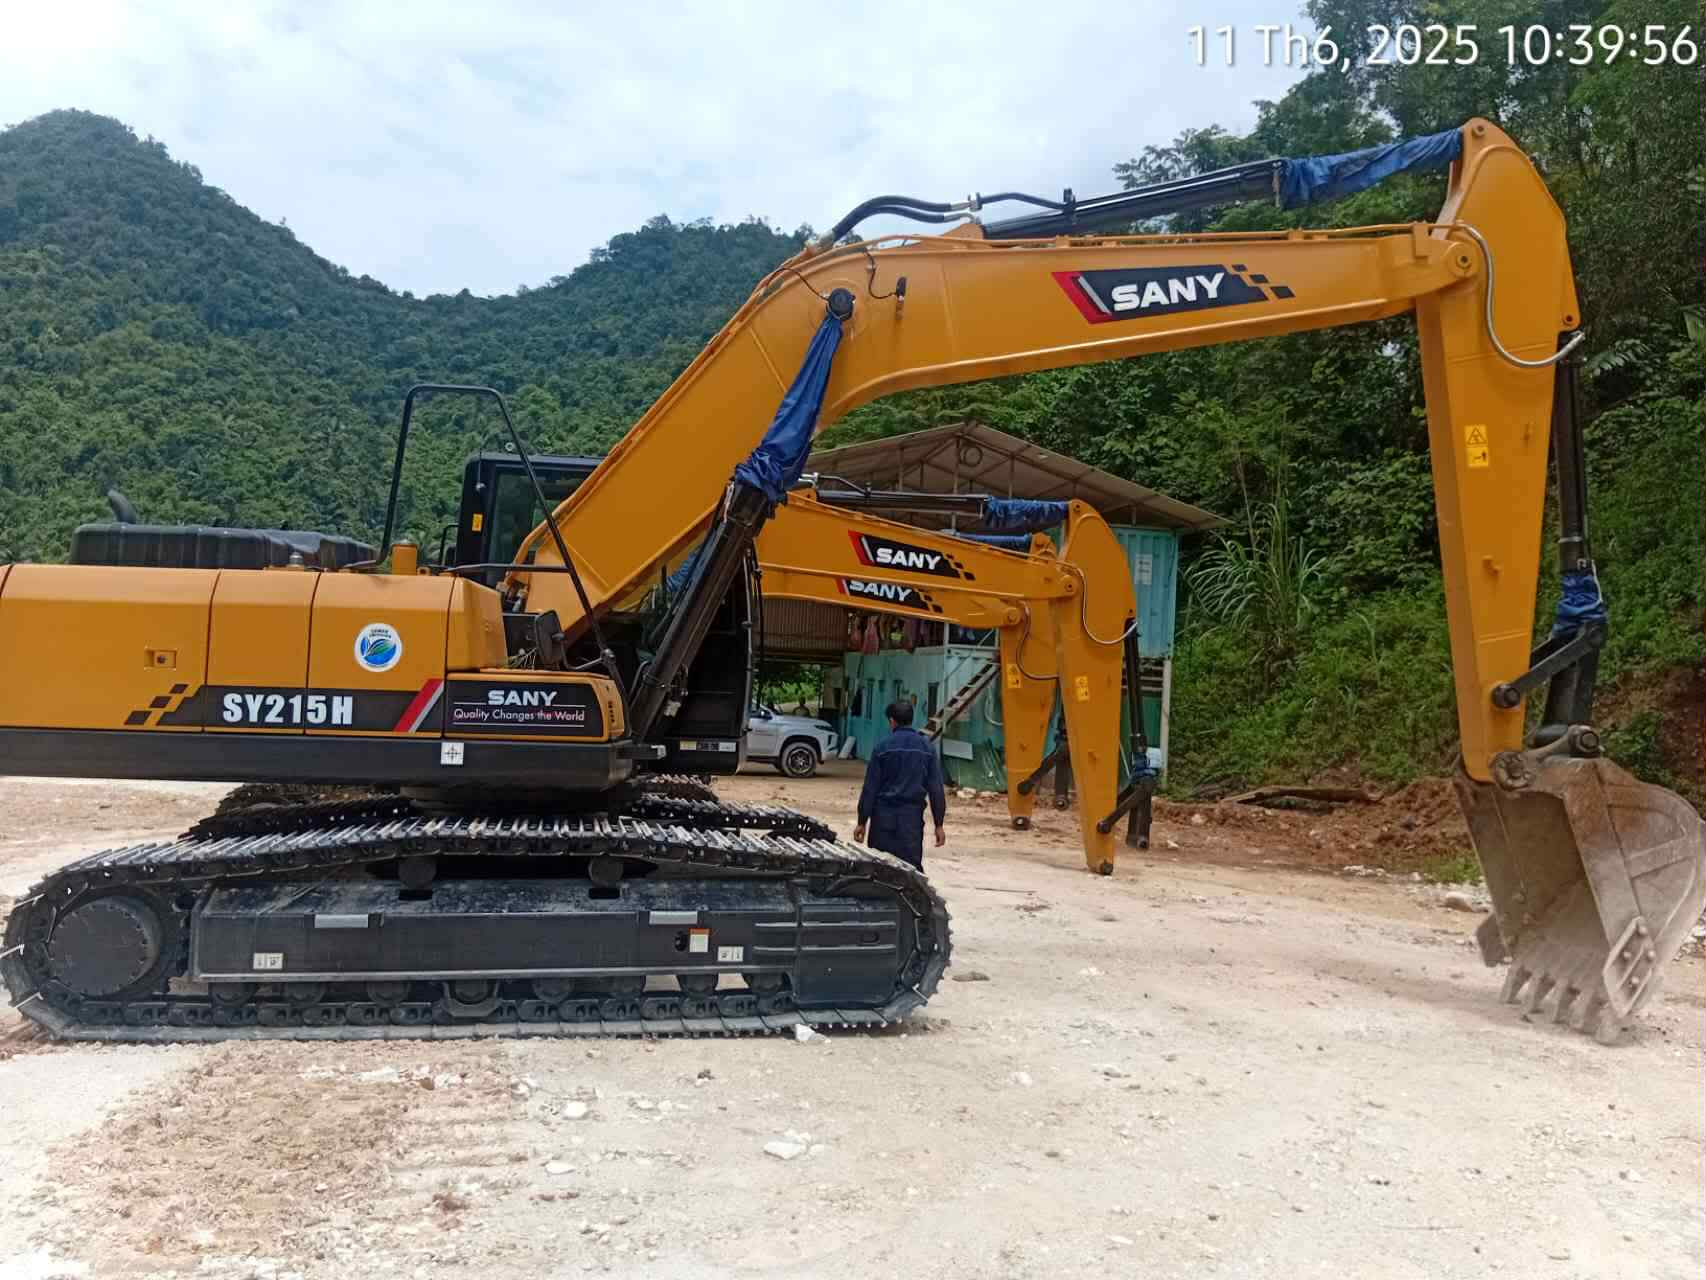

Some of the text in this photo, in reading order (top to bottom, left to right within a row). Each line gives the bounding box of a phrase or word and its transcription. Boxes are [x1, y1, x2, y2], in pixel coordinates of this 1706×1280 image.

[1111, 272, 1225, 312] SANY
[876, 547, 941, 570] SANY
[222, 692, 353, 725] SY215H
[487, 689, 558, 706] SANY
[453, 708, 585, 722] Quality Changes the World
